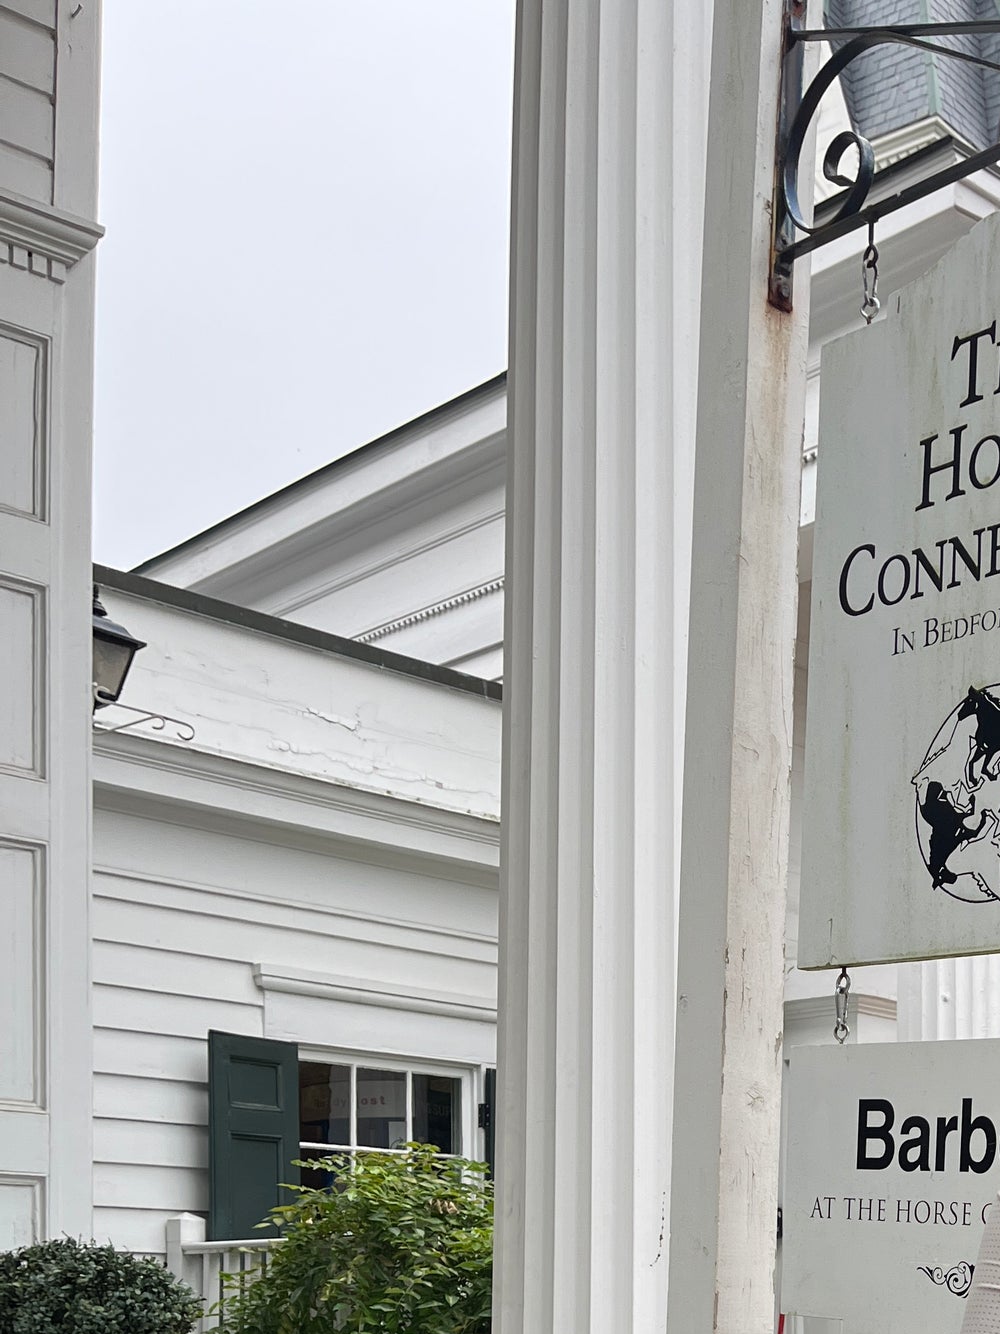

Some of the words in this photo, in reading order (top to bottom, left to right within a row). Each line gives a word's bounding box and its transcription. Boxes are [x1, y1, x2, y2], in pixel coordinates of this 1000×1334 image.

[891, 626, 916, 657] IN
[809, 1196, 837, 1220] AT
[843, 1197, 887, 1222] THE
[895, 1199, 973, 1227] HORSE
